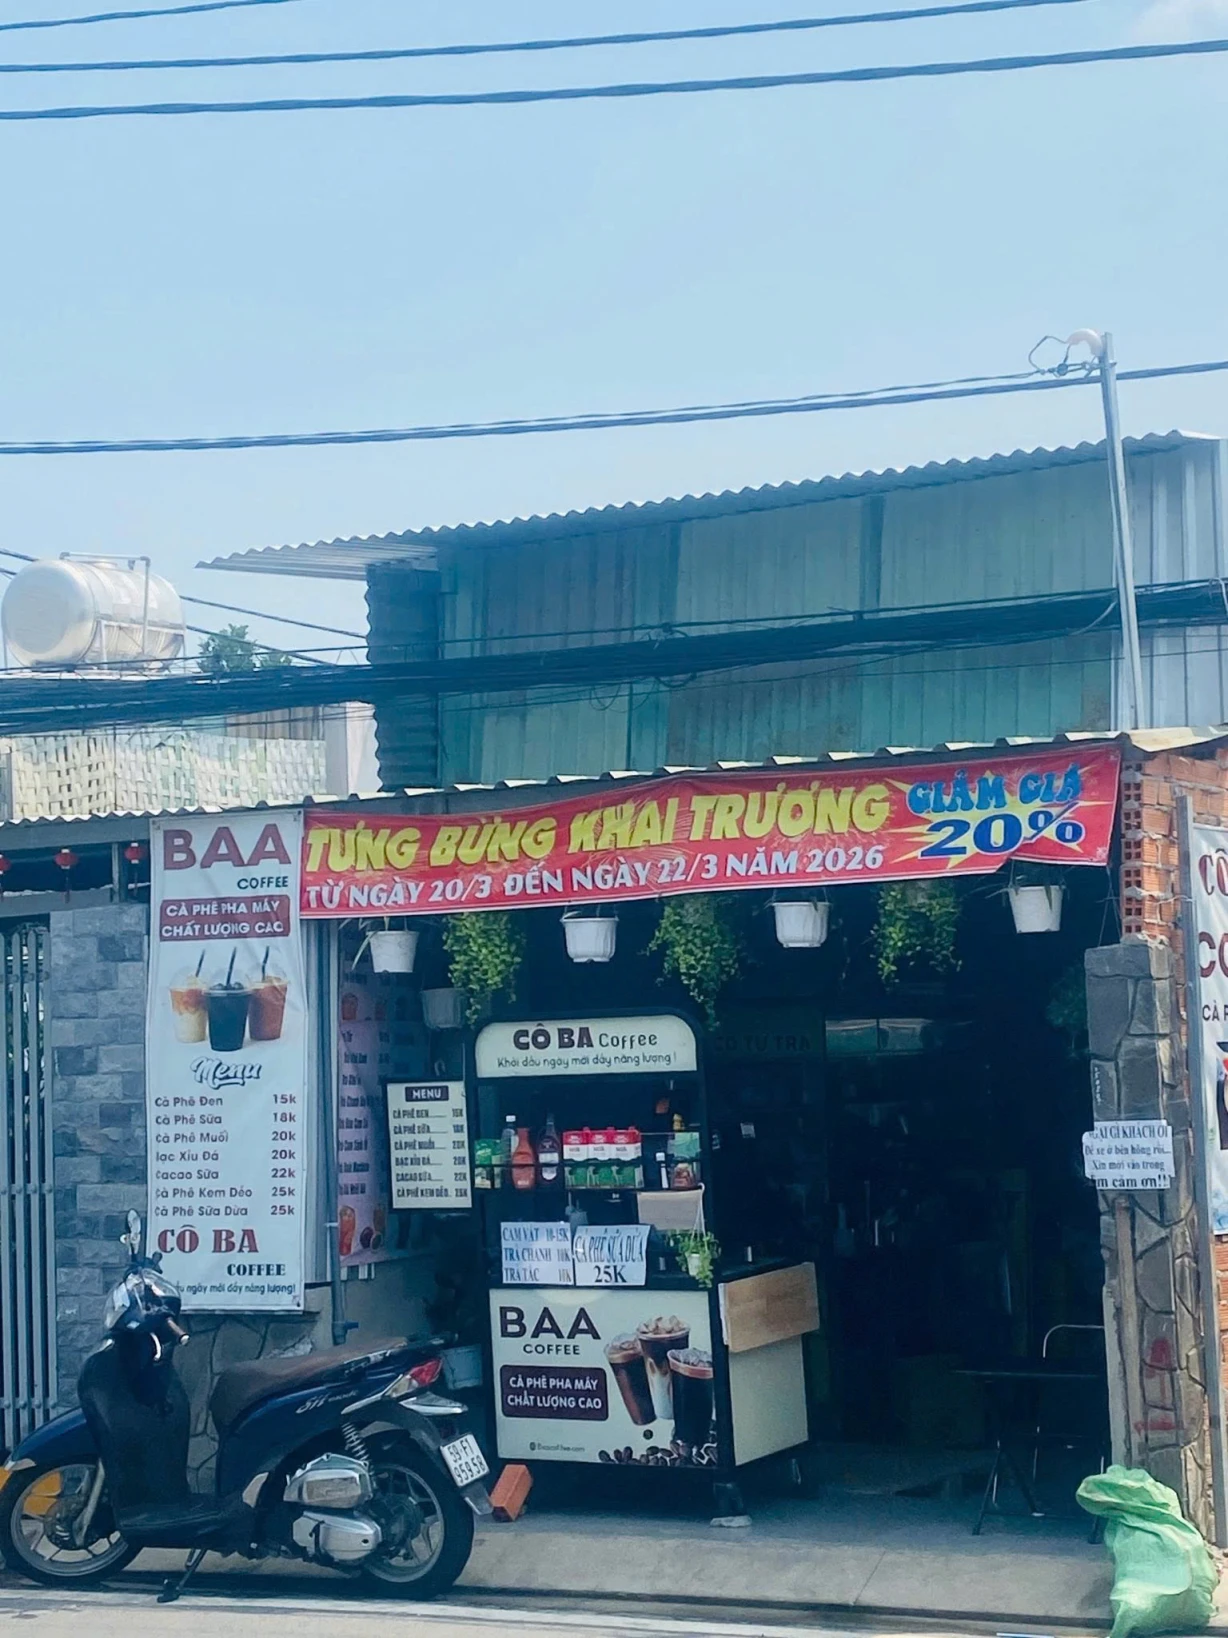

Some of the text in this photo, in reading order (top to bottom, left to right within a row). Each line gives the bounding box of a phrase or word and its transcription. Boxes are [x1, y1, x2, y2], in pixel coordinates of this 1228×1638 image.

[906, 762, 1083, 814] GIẢM GIÁ
[567, 797, 679, 853] KHAI
[689, 780, 890, 841] TRƯƠNG
[918, 801, 1086, 859] 20%
[163, 823, 292, 871] BAA
[237, 876, 289, 890] COFFEE
[306, 844, 886, 909] TỪ NGÀY 20/3 ĐẾN NGÀY 22/3 NĂM 2026
[166, 898, 280, 917] CÀ PHÊ PHA MÁY
[161, 920, 284, 937] CHẤT LƯỢNG CAO
[1202, 1000, 1220, 1021] CÀ
[513, 1023, 658, 1050] CÔ BA Coffee
[543, 1057, 569, 1069] ngày
[190, 1056, 262, 1090] Menu
[173, 1096, 195, 1107] Phê
[199, 1096, 223, 1106] Đen
[273, 1094, 296, 1104] 15k
[412, 1088, 442, 1099] MENU
[174, 1114, 195, 1125] Phê
[199, 1113, 222, 1124] Sữa
[273, 1112, 296, 1122] 18k
[174, 1132, 195, 1143] Phê
[271, 1131, 296, 1141] 20k
[202, 1150, 219, 1161] Đá
[271, 1149, 296, 1160] 20k
[197, 1168, 219, 1179] Sữa
[271, 1168, 296, 1178] 22k
[1112, 1175, 1137, 1188] cảm
[172, 1187, 194, 1198] Phê
[199, 1187, 225, 1197] Kem
[271, 1187, 296, 1197] 25k
[172, 1205, 194, 1216] Phê
[198, 1205, 220, 1216] Sữa
[270, 1205, 295, 1215] 25k
[157, 1224, 260, 1254] CÔ BA
[226, 1263, 286, 1276] COFFEE
[593, 1264, 628, 1283] 25K
[499, 1306, 601, 1340] BAA
[523, 1343, 580, 1355] COFFEE
[509, 1374, 598, 1390] CÀ PHÊ PHA MÁY
[537, 1394, 576, 1410] LƯỢNG
[578, 1397, 602, 1409] CAO
